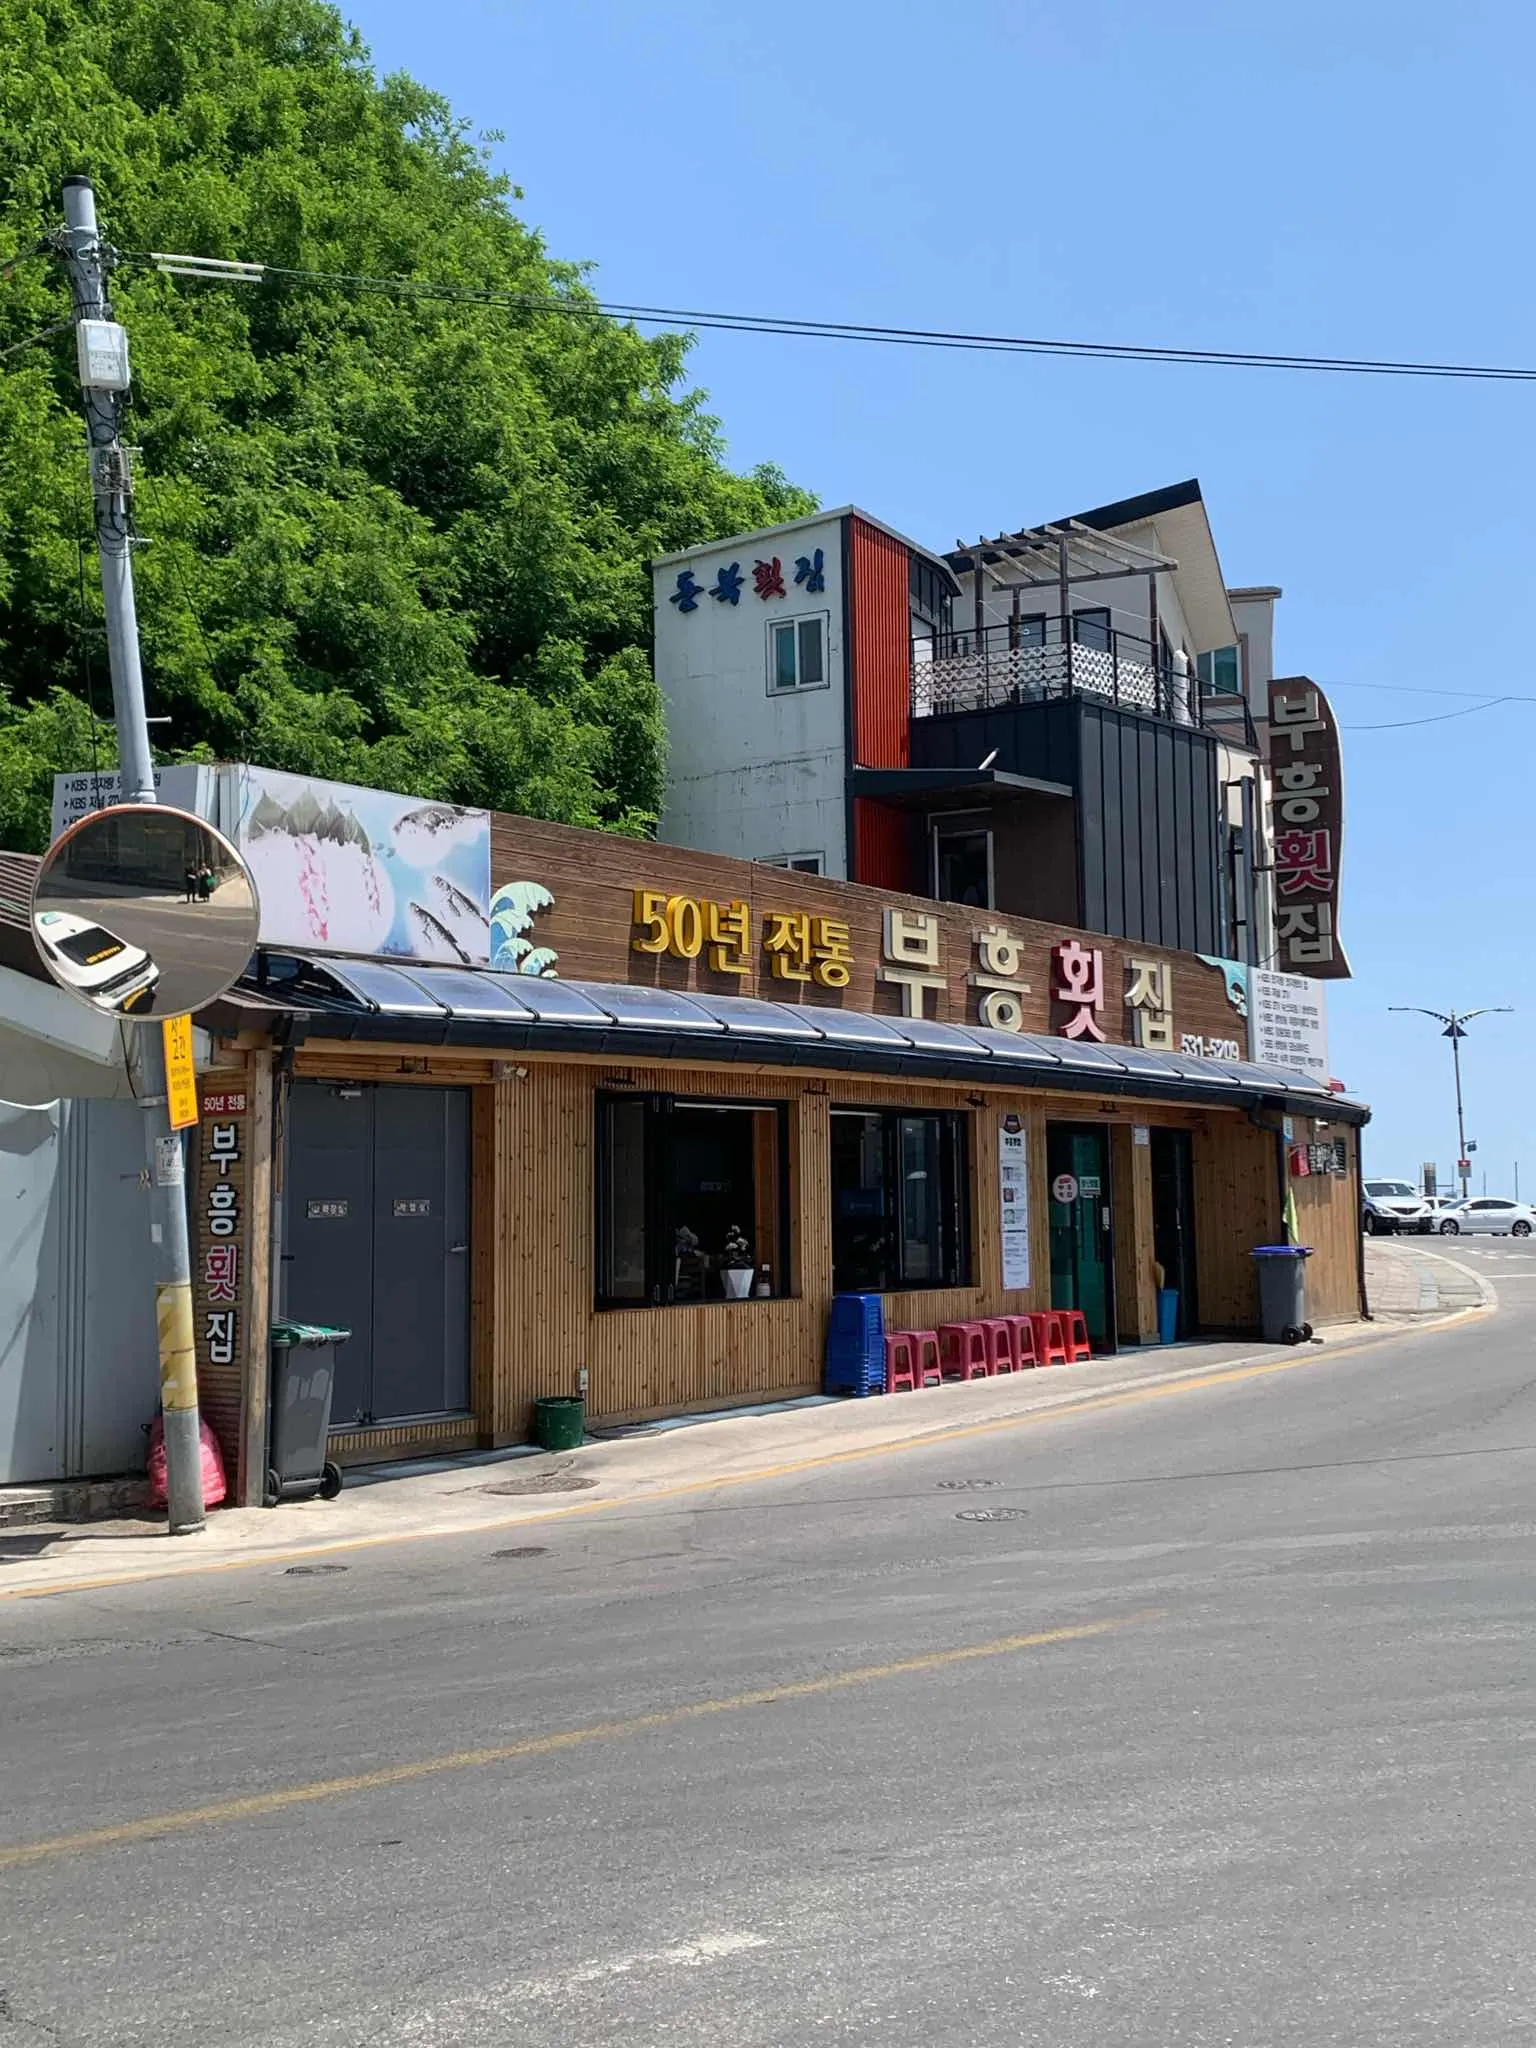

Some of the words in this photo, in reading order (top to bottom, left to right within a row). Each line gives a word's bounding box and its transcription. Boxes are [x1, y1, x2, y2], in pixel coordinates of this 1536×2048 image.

[71, 779, 88, 793] KBS
[69, 797, 87, 811] KBS
[1269, 691, 1334, 963] 부흥횟집
[632, 889, 753, 974] 50년
[764, 911, 856, 987] 전통
[876, 908, 1175, 1052] 부흥횟집
[1181, 1033, 1240, 1060] 531-5209
[203, 1095, 224, 1112] 50년
[227, 1094, 246, 1111] 전통
[205, 1124, 240, 1366] 부흥횟집
